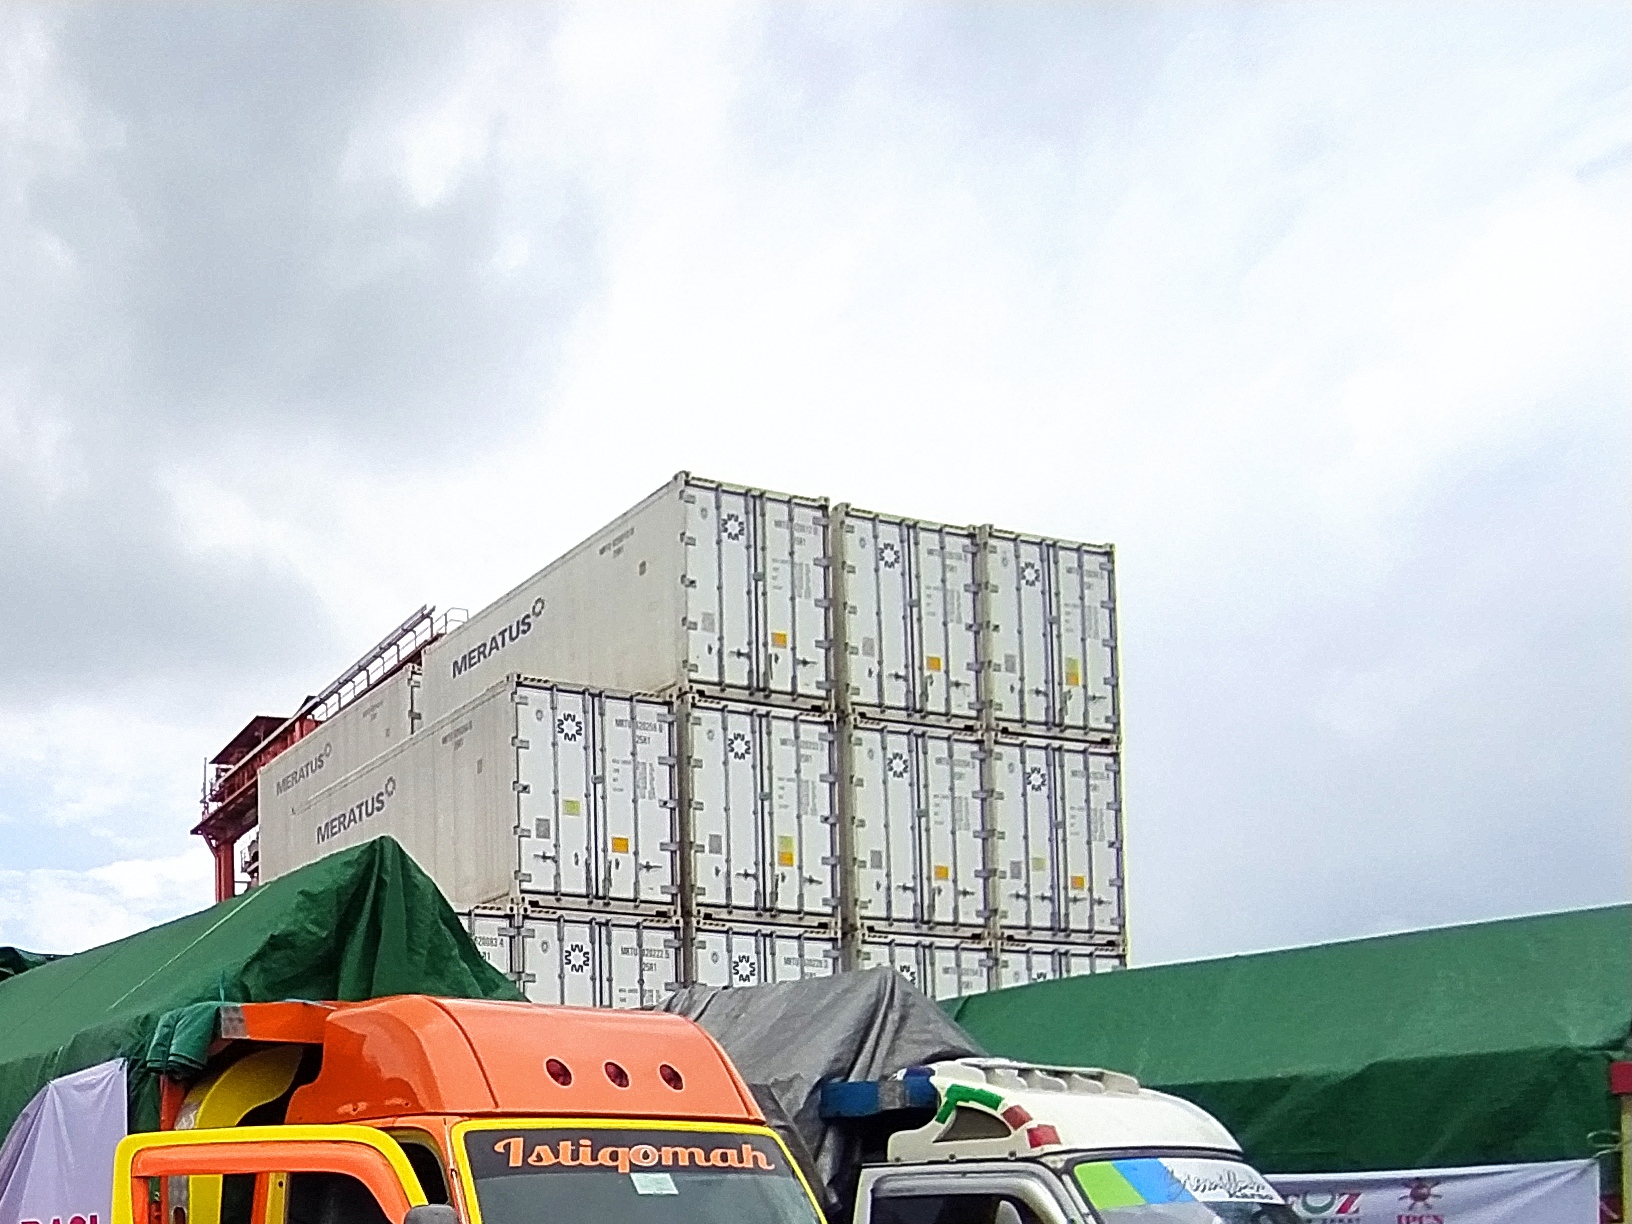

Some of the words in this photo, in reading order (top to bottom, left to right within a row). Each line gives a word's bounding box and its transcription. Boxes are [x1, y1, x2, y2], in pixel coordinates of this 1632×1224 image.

[452, 614, 533, 679] MERATUS
[276, 754, 325, 796] MERATUS
[317, 792, 386, 844] MERATUS
[494, 1137, 776, 1173] Istiqomah
